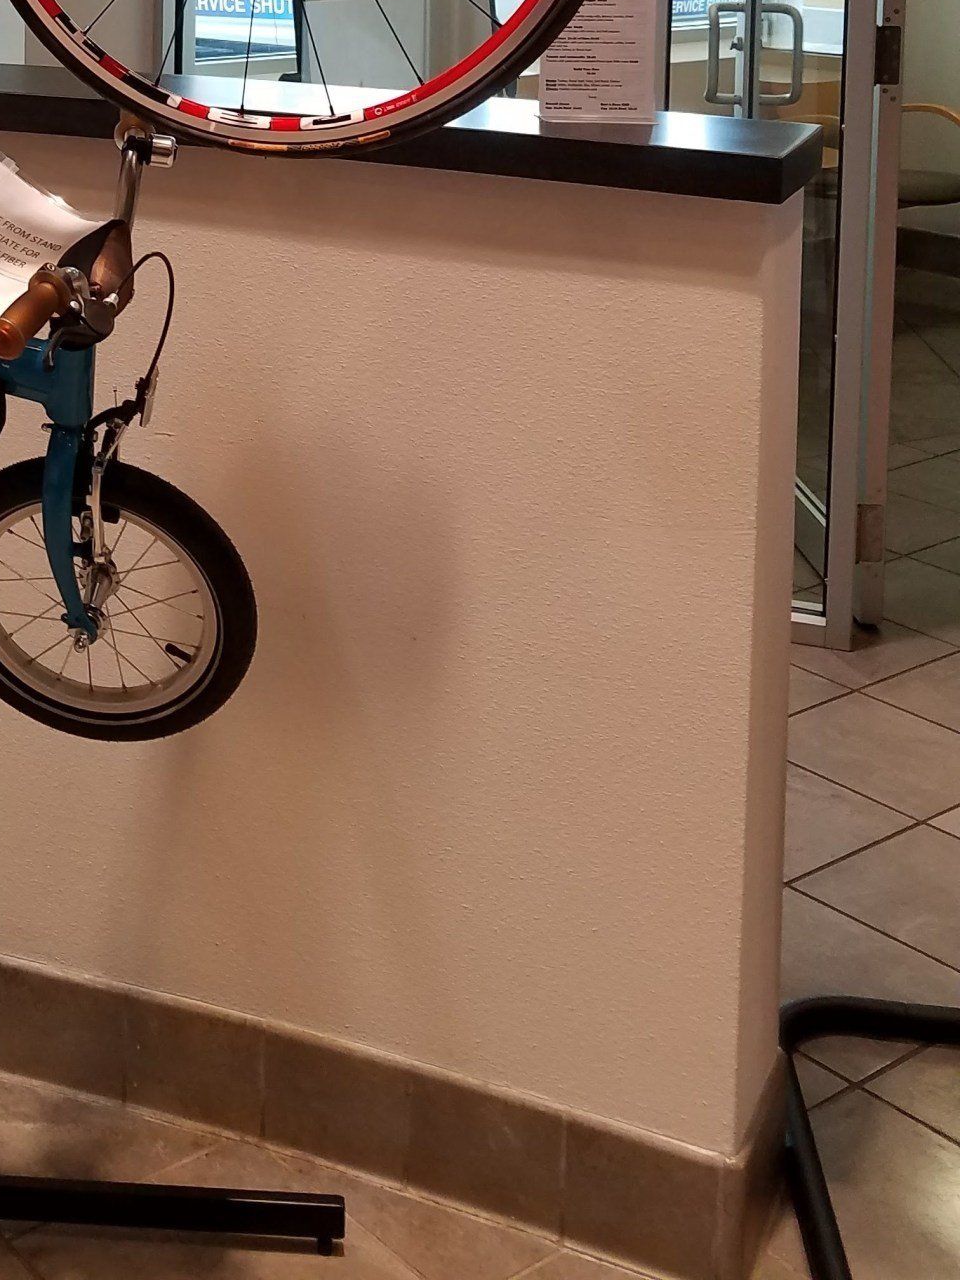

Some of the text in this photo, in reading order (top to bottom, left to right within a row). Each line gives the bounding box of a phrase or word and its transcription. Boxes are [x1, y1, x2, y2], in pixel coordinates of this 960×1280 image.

[2, 220, 31, 240] FROM
[30, 236, 62, 252] STAND
[0, 252, 27, 269] FIBER
[20, 246, 41, 259] FOR
